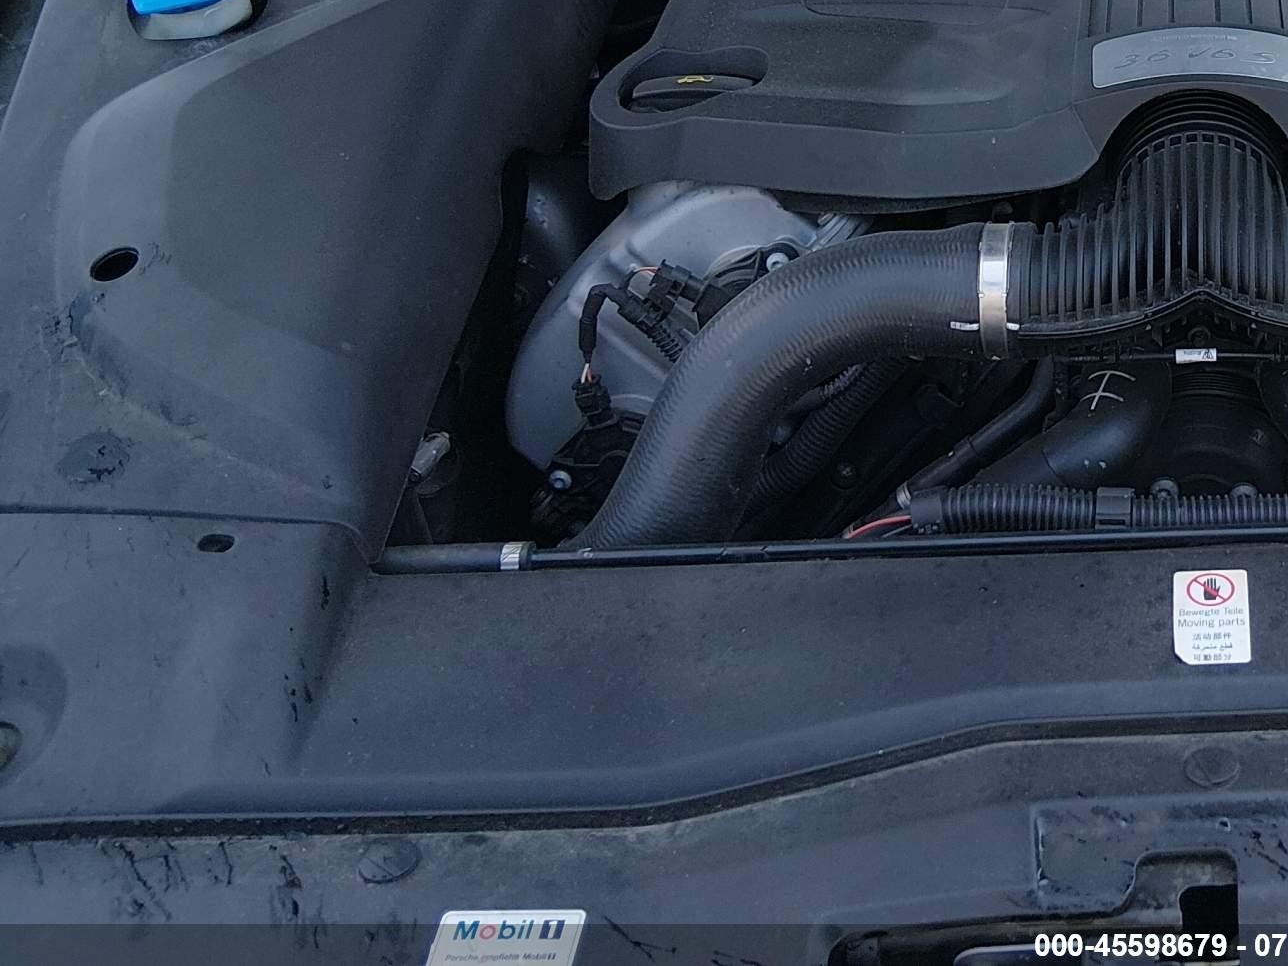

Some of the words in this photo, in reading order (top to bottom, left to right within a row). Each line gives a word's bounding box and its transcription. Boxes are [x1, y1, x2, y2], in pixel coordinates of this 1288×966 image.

[1178, 608, 1220, 617] Bewegte
[1224, 606, 1244, 615] Teile
[1177, 618, 1215, 628] Moving
[1218, 617, 1246, 627] parts
[453, 919, 534, 941] Mobil
